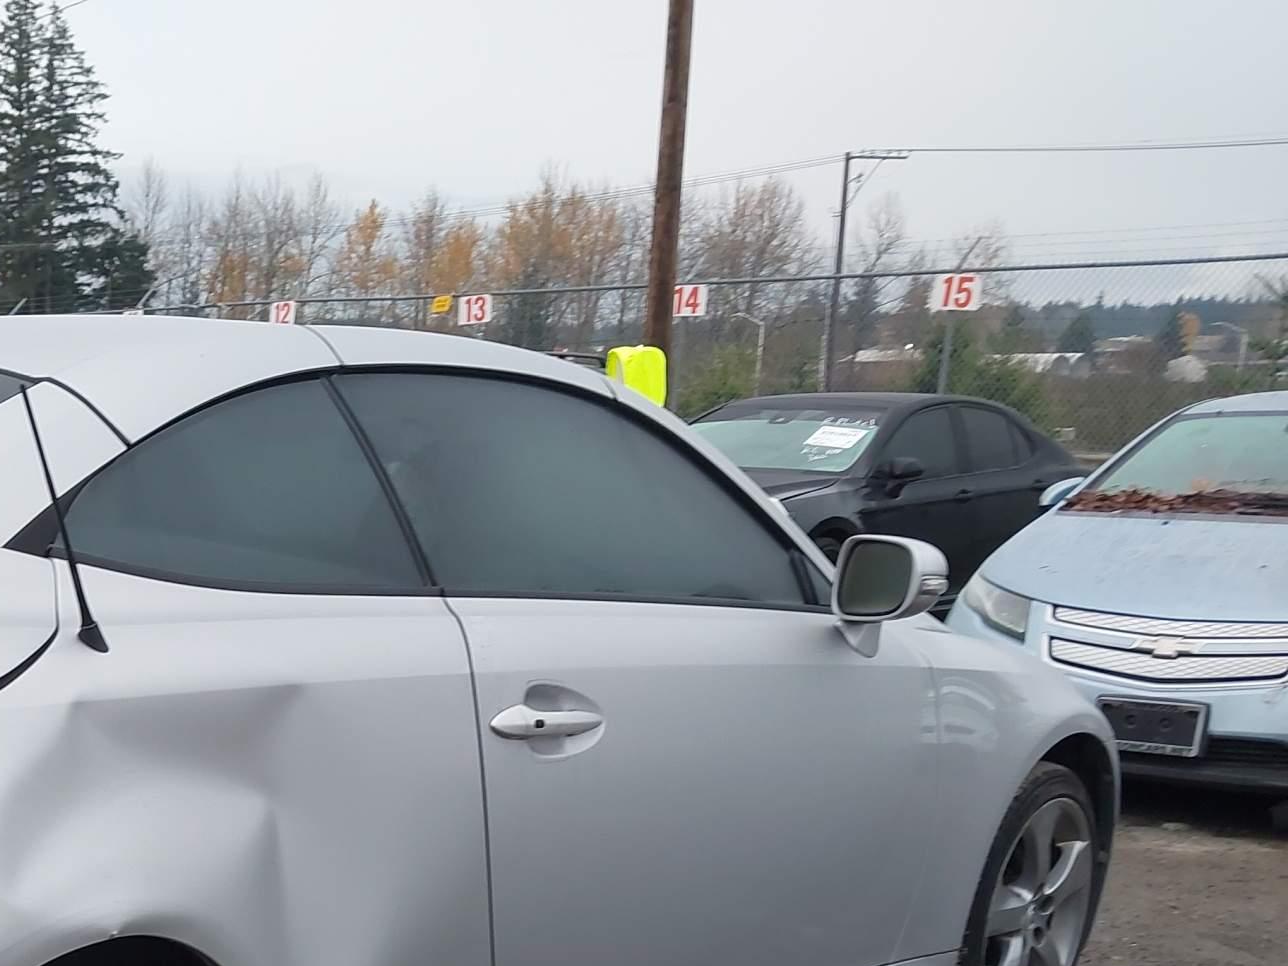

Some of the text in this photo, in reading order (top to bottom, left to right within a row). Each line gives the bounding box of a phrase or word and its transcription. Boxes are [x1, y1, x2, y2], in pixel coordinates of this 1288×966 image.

[674, 287, 699, 314] 14
[943, 276, 976, 308] 15
[275, 303, 290, 323] 12
[466, 296, 486, 322] 13
